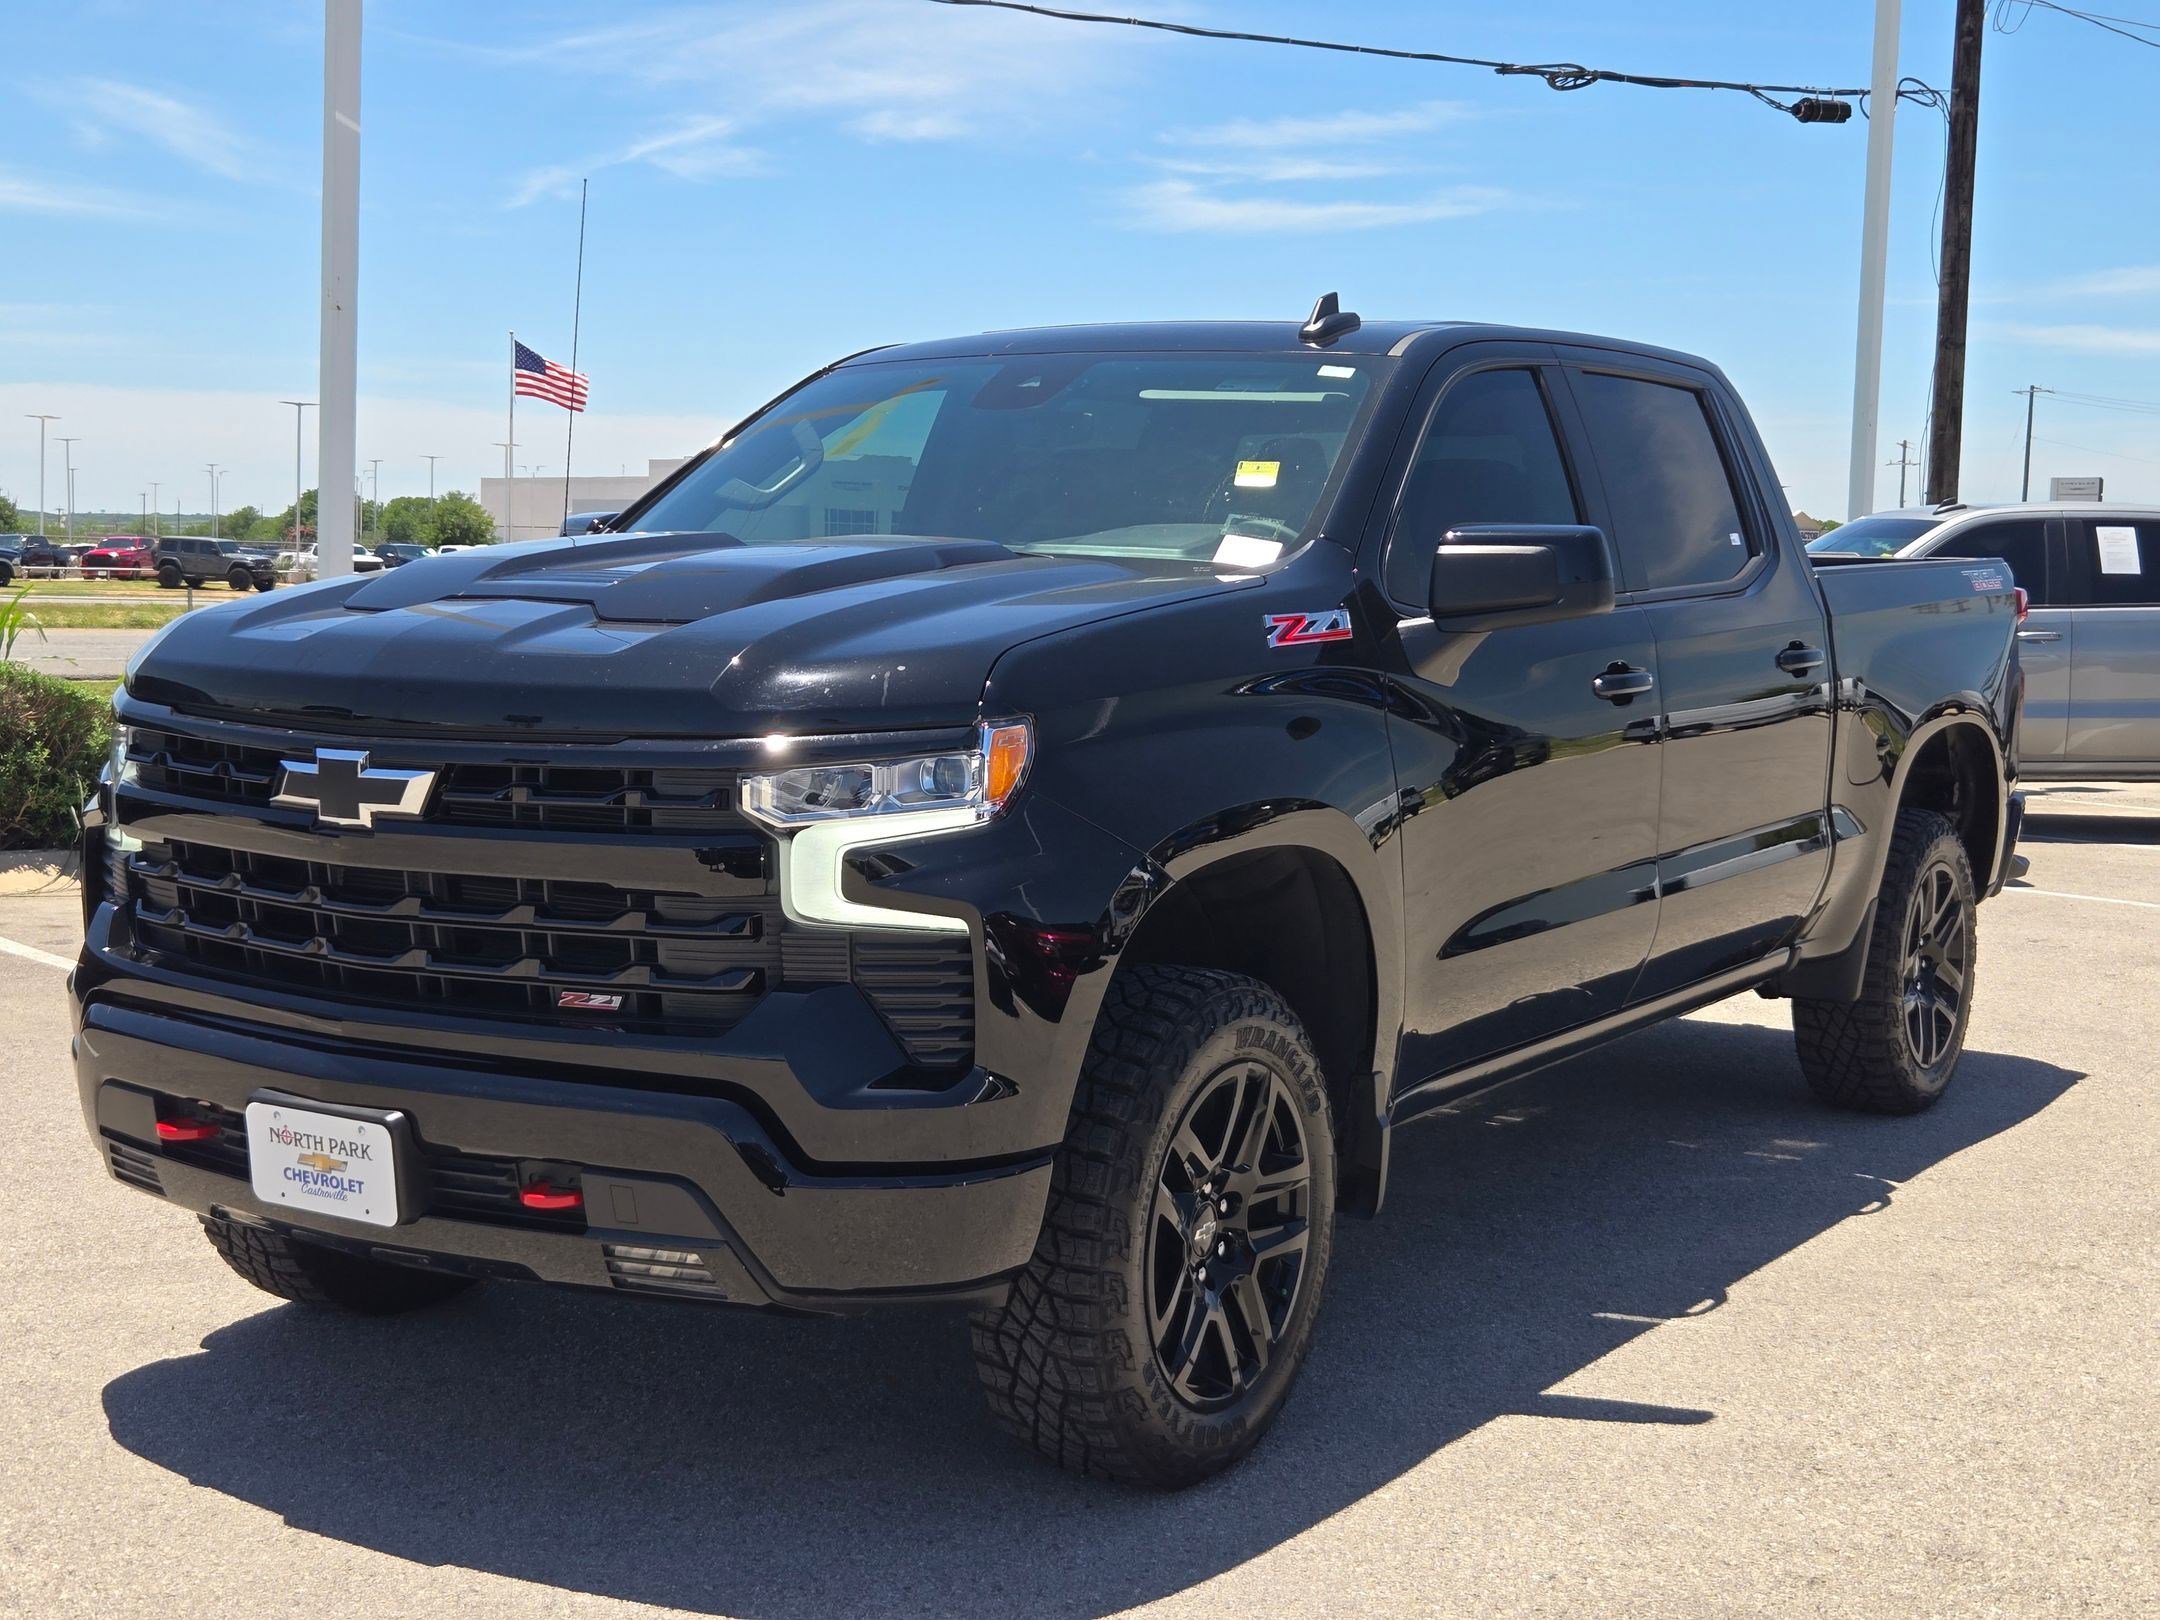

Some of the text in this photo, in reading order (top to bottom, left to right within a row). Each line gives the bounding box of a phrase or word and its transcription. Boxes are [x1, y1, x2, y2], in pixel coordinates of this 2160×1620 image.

[1263, 608, 1353, 648] Z71
[557, 991, 622, 1011] Z71
[1234, 1025, 1321, 1115] WRANGLER
[269, 1125, 374, 1161] NORTH PARK
[283, 1166, 364, 1195] CHEVROLET
[300, 1182, 349, 1202] Castroville
